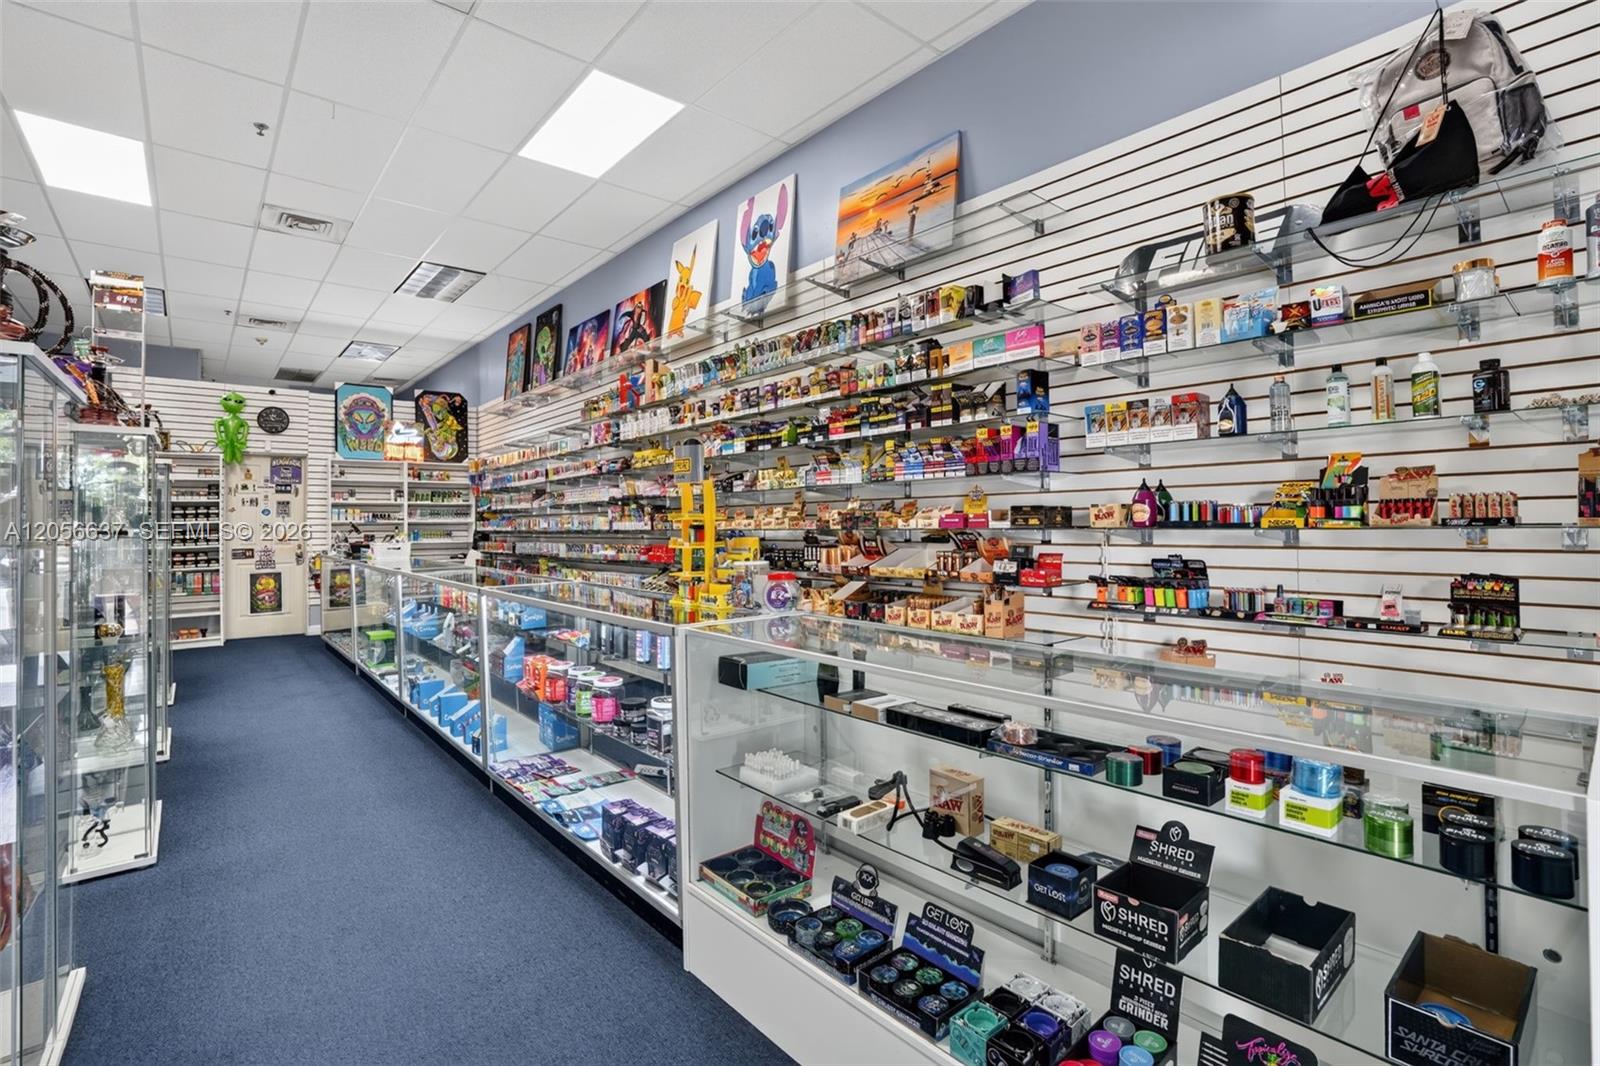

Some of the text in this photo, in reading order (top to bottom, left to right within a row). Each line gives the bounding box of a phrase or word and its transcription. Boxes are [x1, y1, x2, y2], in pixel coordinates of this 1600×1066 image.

[1150, 840, 1194, 862] SHRED
[926, 905, 970, 936] GET LOST
[1118, 908, 1168, 935] SHRED
[1119, 964, 1176, 998] SHRED
[1119, 999, 1168, 1031] GRINDER
[1394, 1025, 1446, 1054] SANTA
